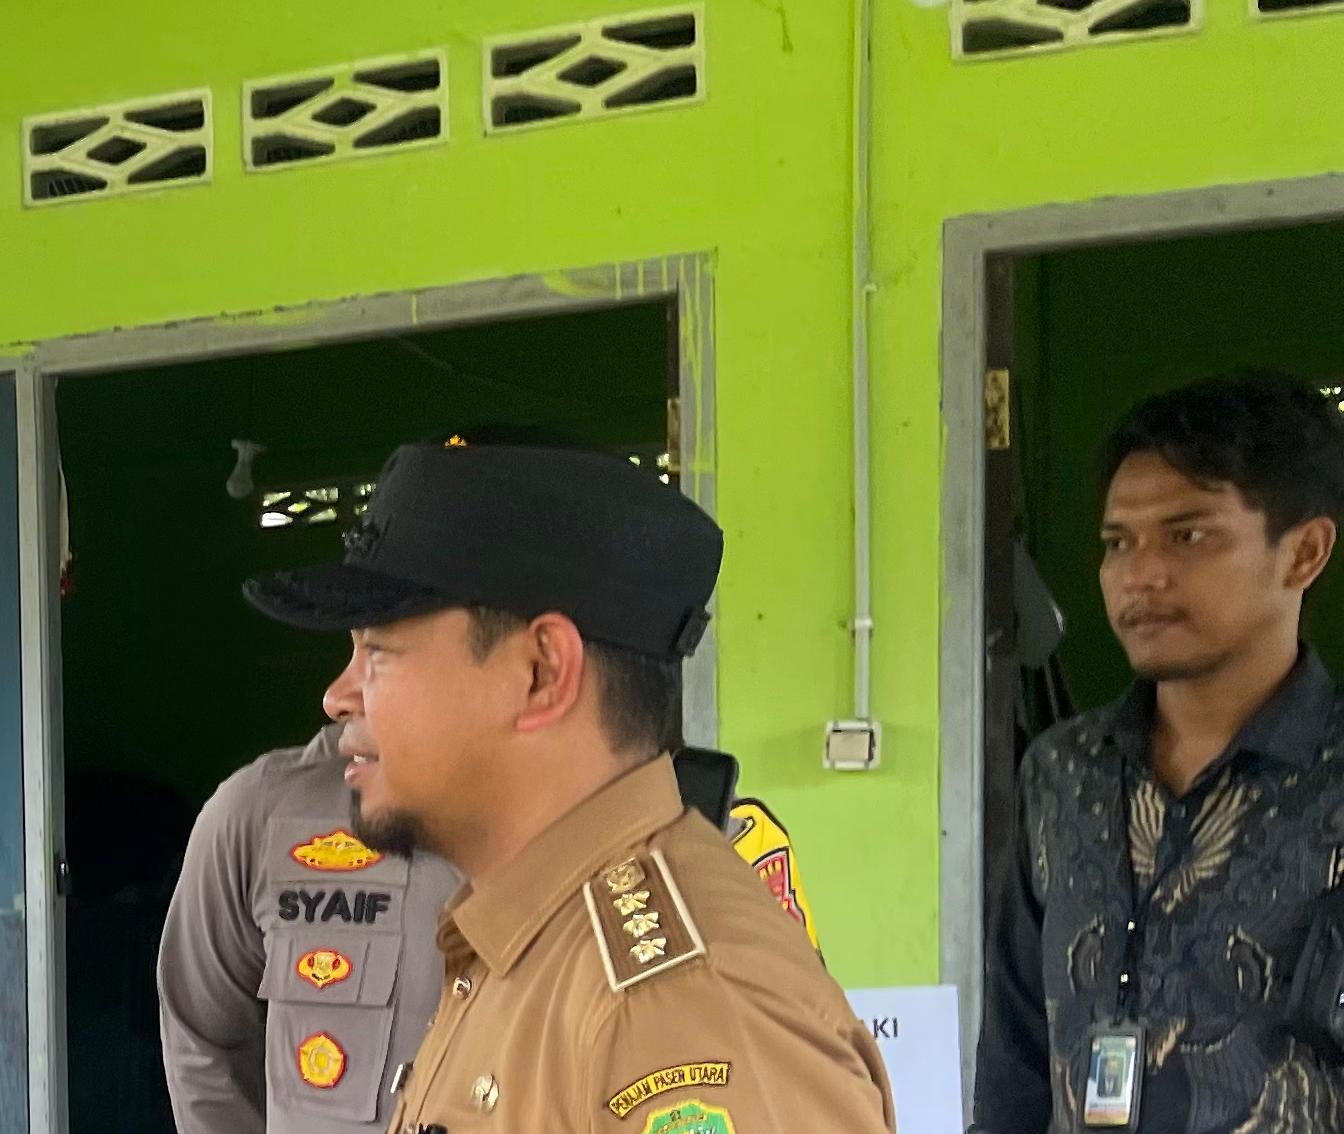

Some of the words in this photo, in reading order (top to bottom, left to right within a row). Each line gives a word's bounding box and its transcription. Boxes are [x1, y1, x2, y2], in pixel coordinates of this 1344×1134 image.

[278, 889, 390, 923] SYAIF
[873, 1017, 899, 1039] KI
[611, 1083, 654, 1111] PENAJAM
[654, 1069, 686, 1091] PASER
[690, 1066, 725, 1082] UTARA
